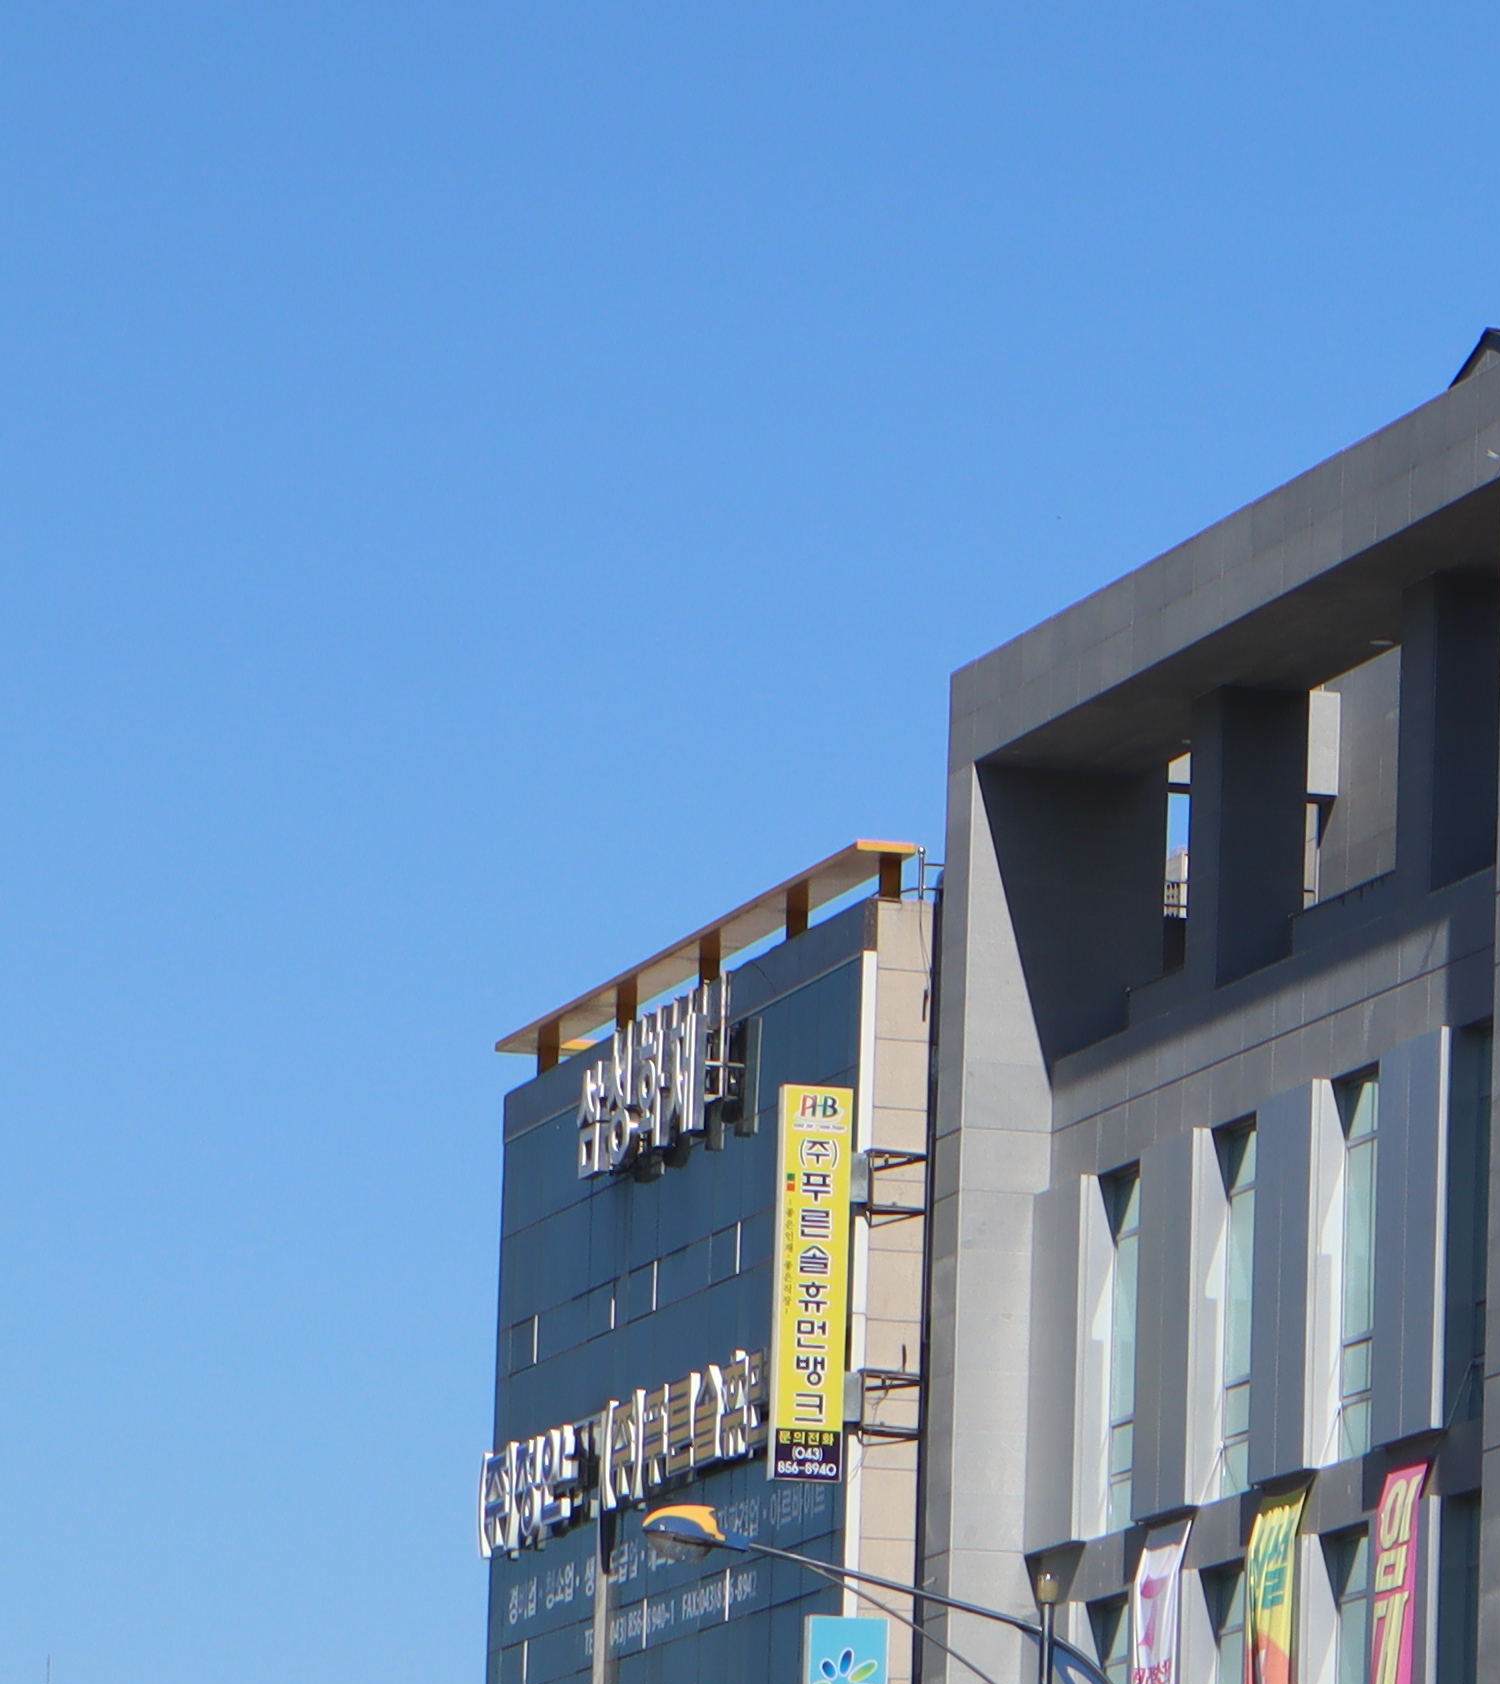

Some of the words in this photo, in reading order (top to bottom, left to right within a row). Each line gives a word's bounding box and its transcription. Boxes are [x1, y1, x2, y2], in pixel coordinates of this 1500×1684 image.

[778, 1430, 835, 1447] 문의전화
[791, 1445, 823, 1461] (043)
[777, 1460, 837, 1477] 856-8940
